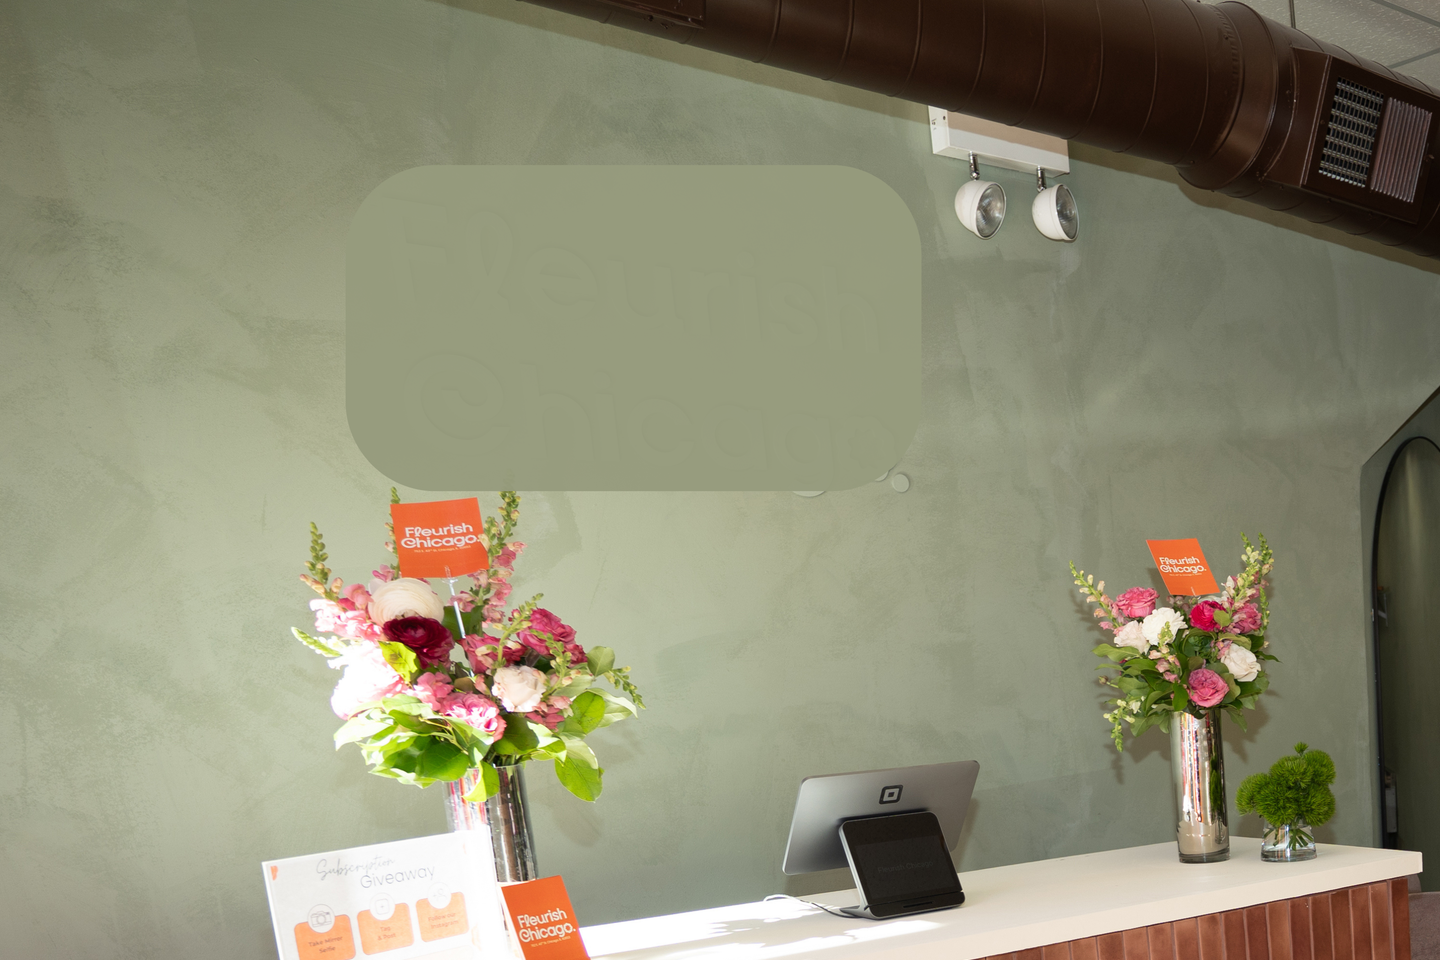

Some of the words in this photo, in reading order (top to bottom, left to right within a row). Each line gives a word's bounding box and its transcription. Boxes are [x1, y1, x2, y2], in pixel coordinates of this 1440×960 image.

[404, 523, 473, 537] Fleurish
[1159, 556, 1200, 565] Fleurish
[316, 856, 396, 881] Subscription
[360, 866, 435, 889] Giveaway
[517, 907, 568, 928] Fleurish
[519, 922, 576, 942] Chicago.
